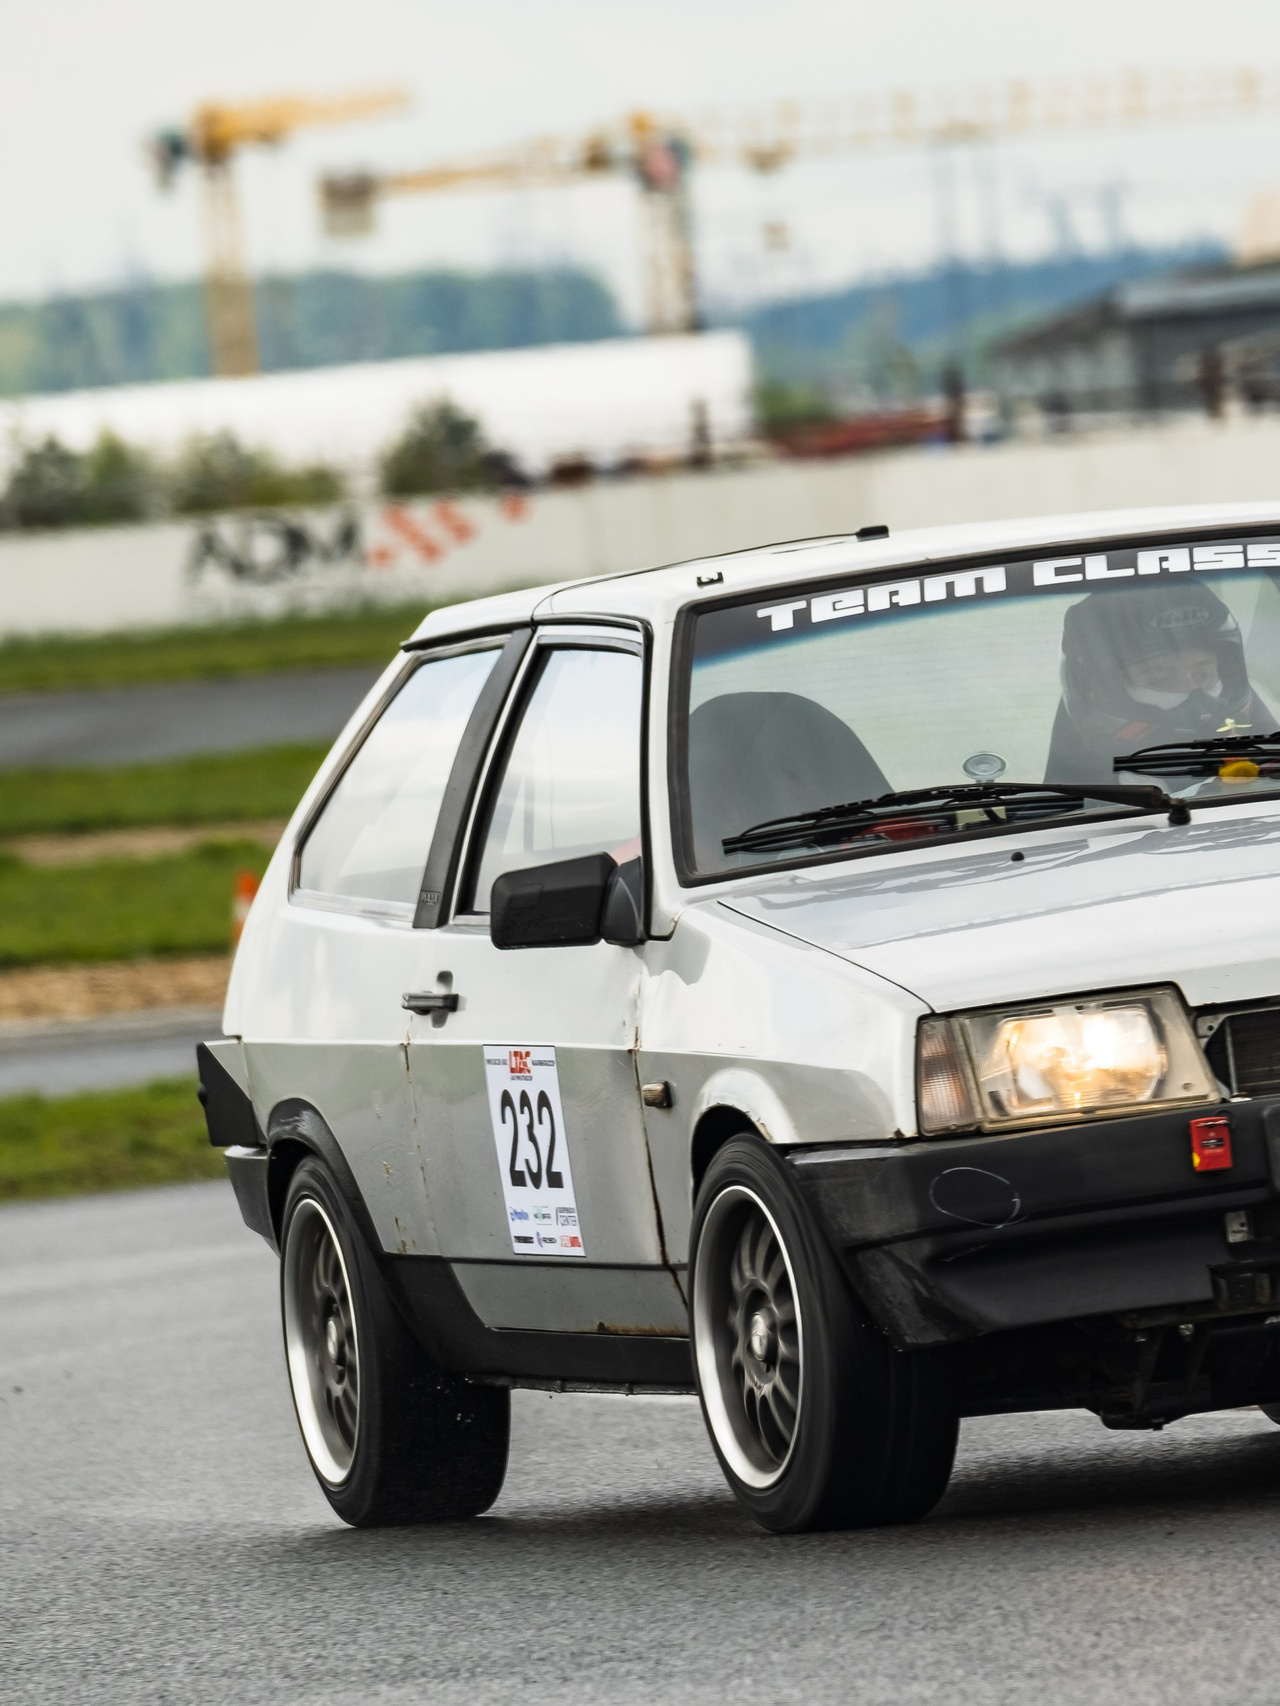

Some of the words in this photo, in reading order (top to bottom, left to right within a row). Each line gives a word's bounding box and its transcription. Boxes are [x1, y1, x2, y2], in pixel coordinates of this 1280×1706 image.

[187, 507, 364, 583] ADM
[757, 567, 1006, 631] TEAM
[501, 1089, 564, 1189] 232
